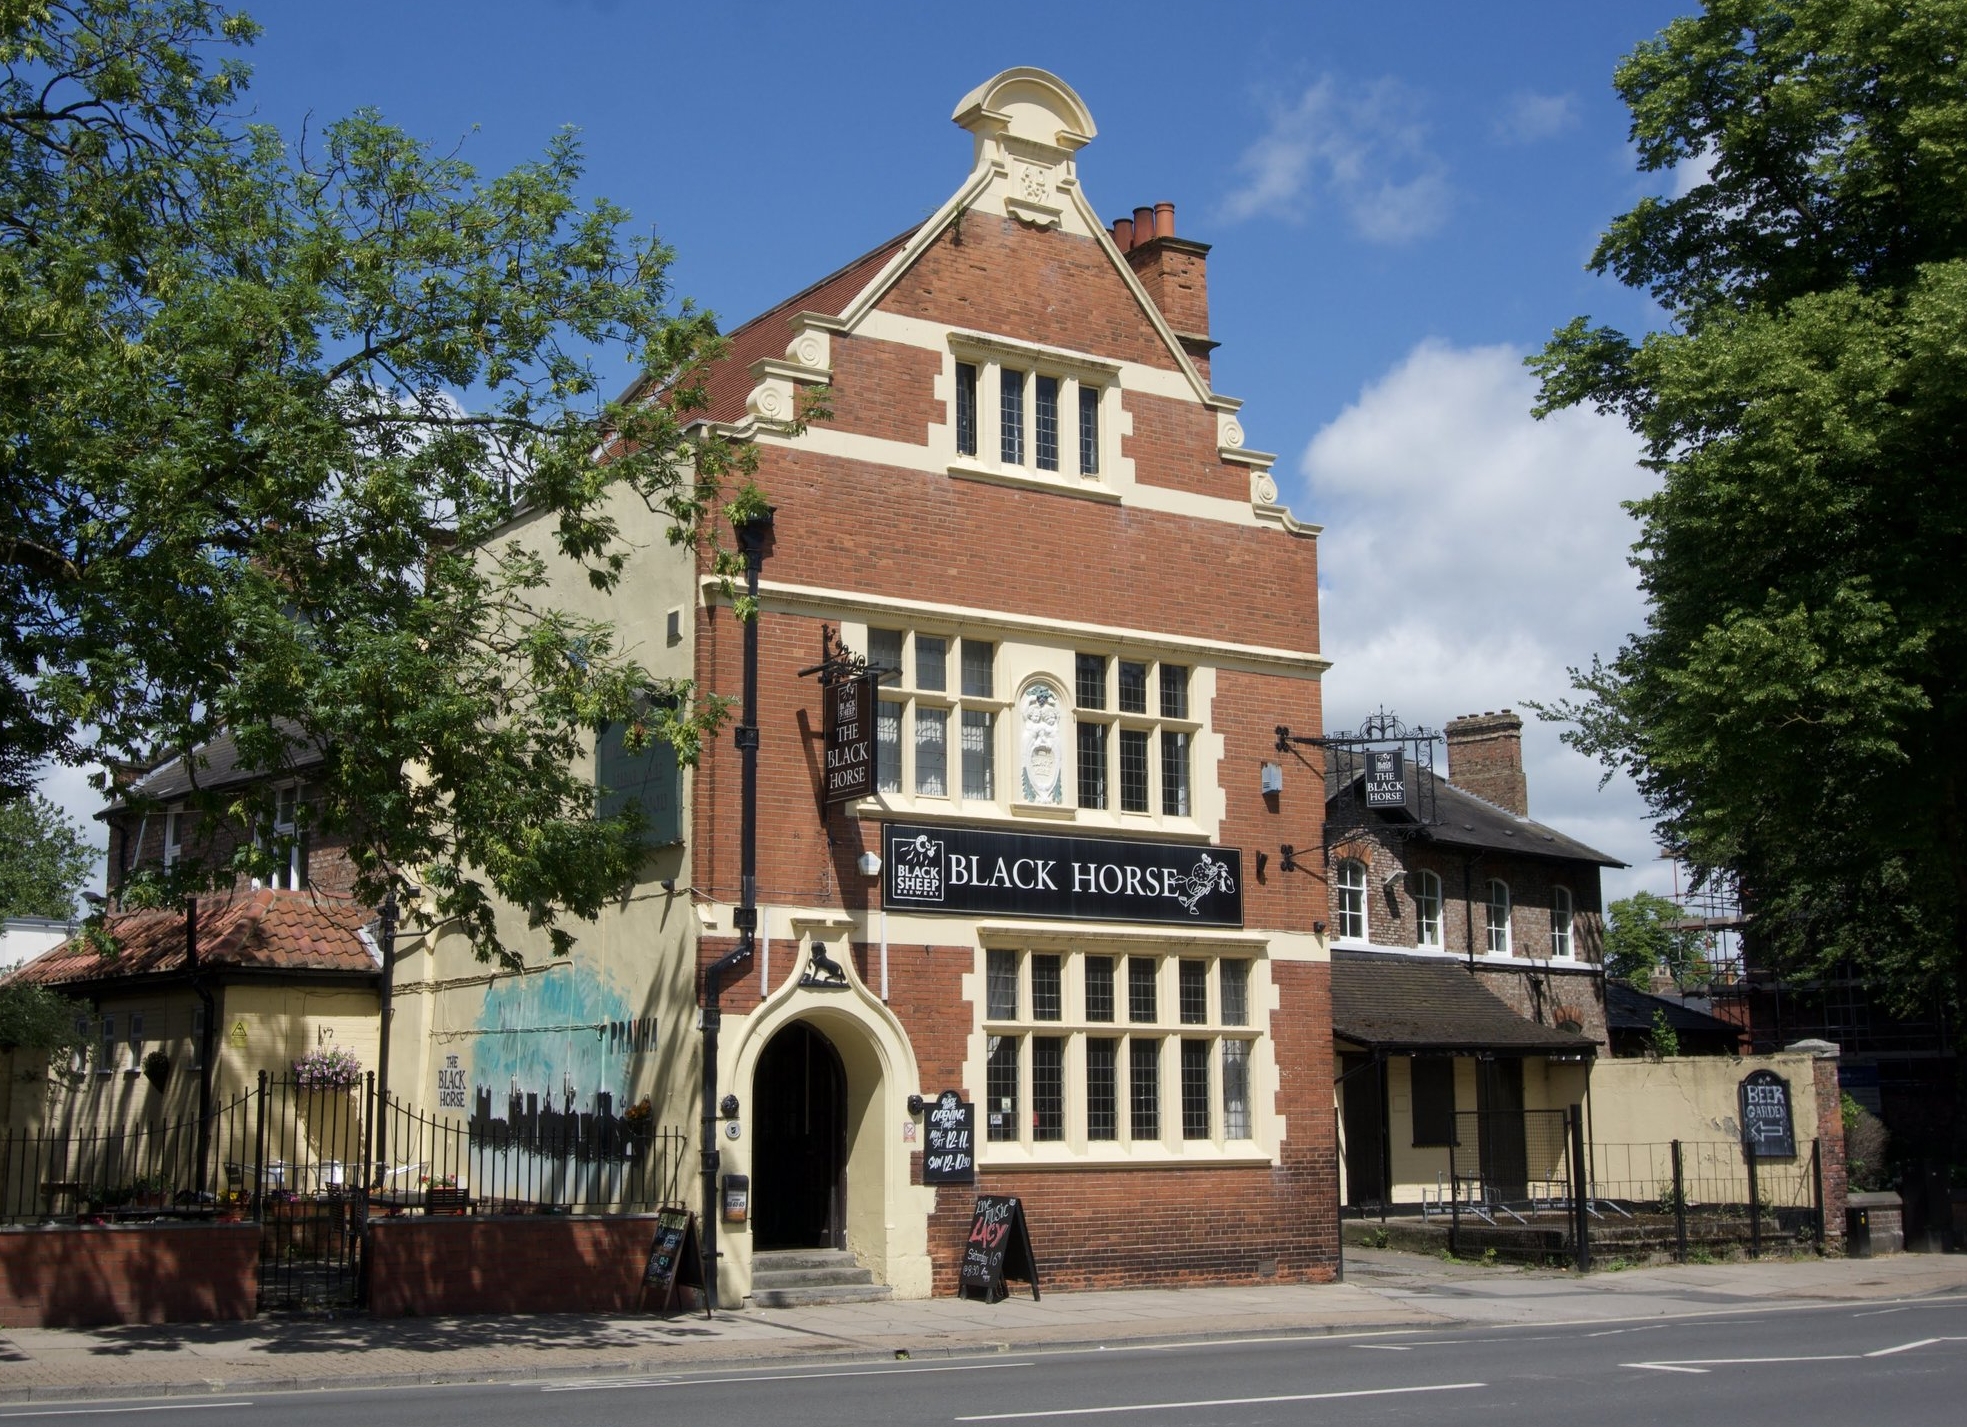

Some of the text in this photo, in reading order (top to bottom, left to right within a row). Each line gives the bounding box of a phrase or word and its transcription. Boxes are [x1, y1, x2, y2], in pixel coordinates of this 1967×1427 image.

[837, 723, 859, 742] THE
[828, 742, 868, 768] BLACK
[830, 767, 866, 789] HORSE
[1374, 772, 1395, 781] THE
[1367, 781, 1404, 791] BLACK
[1370, 792, 1403, 801] HORSE
[897, 865, 939, 879] BLACK
[949, 854, 1180, 898] BLACK HORSE
[897, 877, 939, 891] SHEEP
[897, 889, 939, 897] BREWERY
[446, 1055, 458, 1069] THE
[438, 1070, 466, 1090] BLACK
[439, 1091, 466, 1108] HORSE
[1747, 1085, 1785, 1104] BEER
[931, 1109, 966, 1122] OPENING
[1746, 1105, 1786, 1118] GARDEN
[940, 1120, 957, 1130] TIMES
[928, 1155, 943, 1170] SUN
[969, 1216, 1009, 1249] LACY
